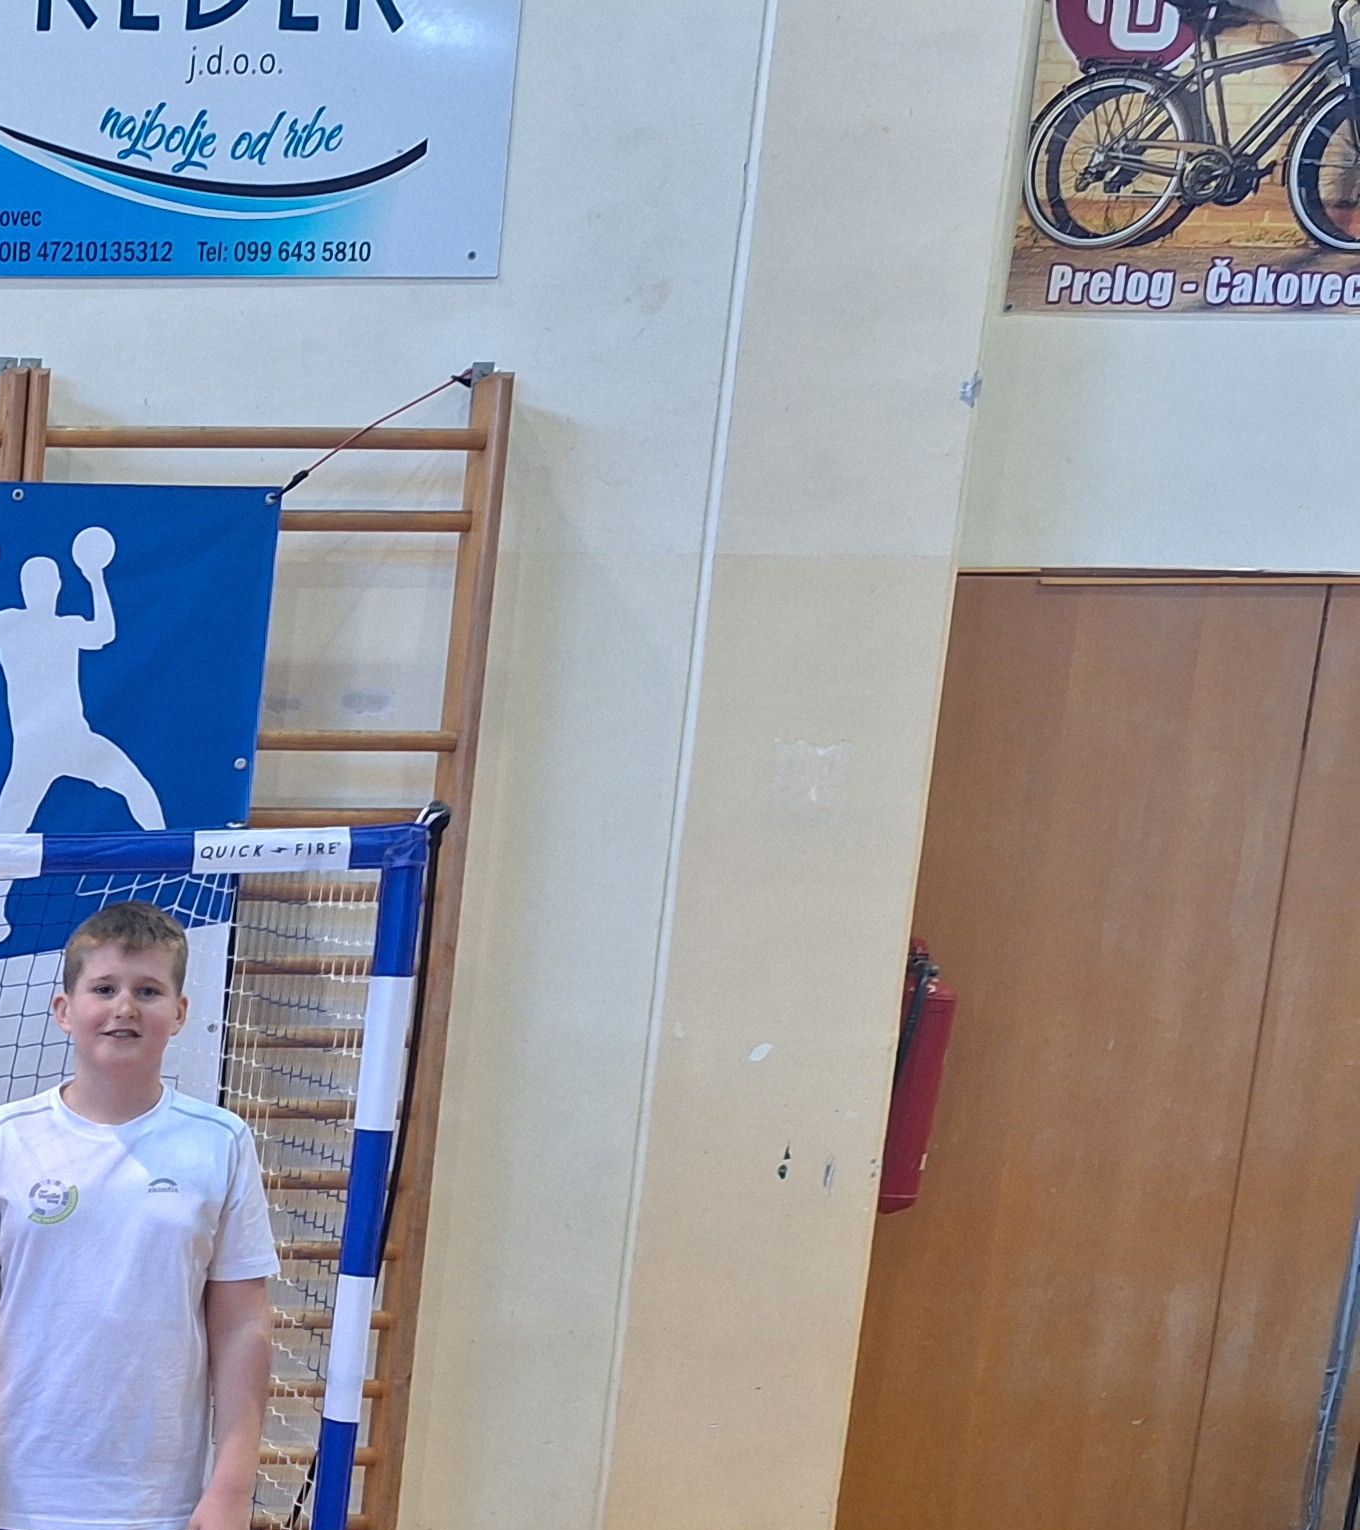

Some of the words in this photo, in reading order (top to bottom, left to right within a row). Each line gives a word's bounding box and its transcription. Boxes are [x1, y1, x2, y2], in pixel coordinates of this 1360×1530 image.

[185, 45, 283, 84] j.d.o.o.
[100, 102, 216, 173] najbolje
[231, 111, 286, 165] od
[283, 106, 343, 161] ribe
[37, 241, 173, 262] 47210135312
[197, 241, 228, 262] Tel:
[233, 241, 272, 262] 099
[278, 241, 316, 262] 643
[322, 241, 372, 262] 5810
[1046, 264, 1176, 308] Prelog
[1205, 257, 1360, 307] Čakovec
[200, 844, 264, 860] QUICK
[294, 842, 336, 856] FIRE
